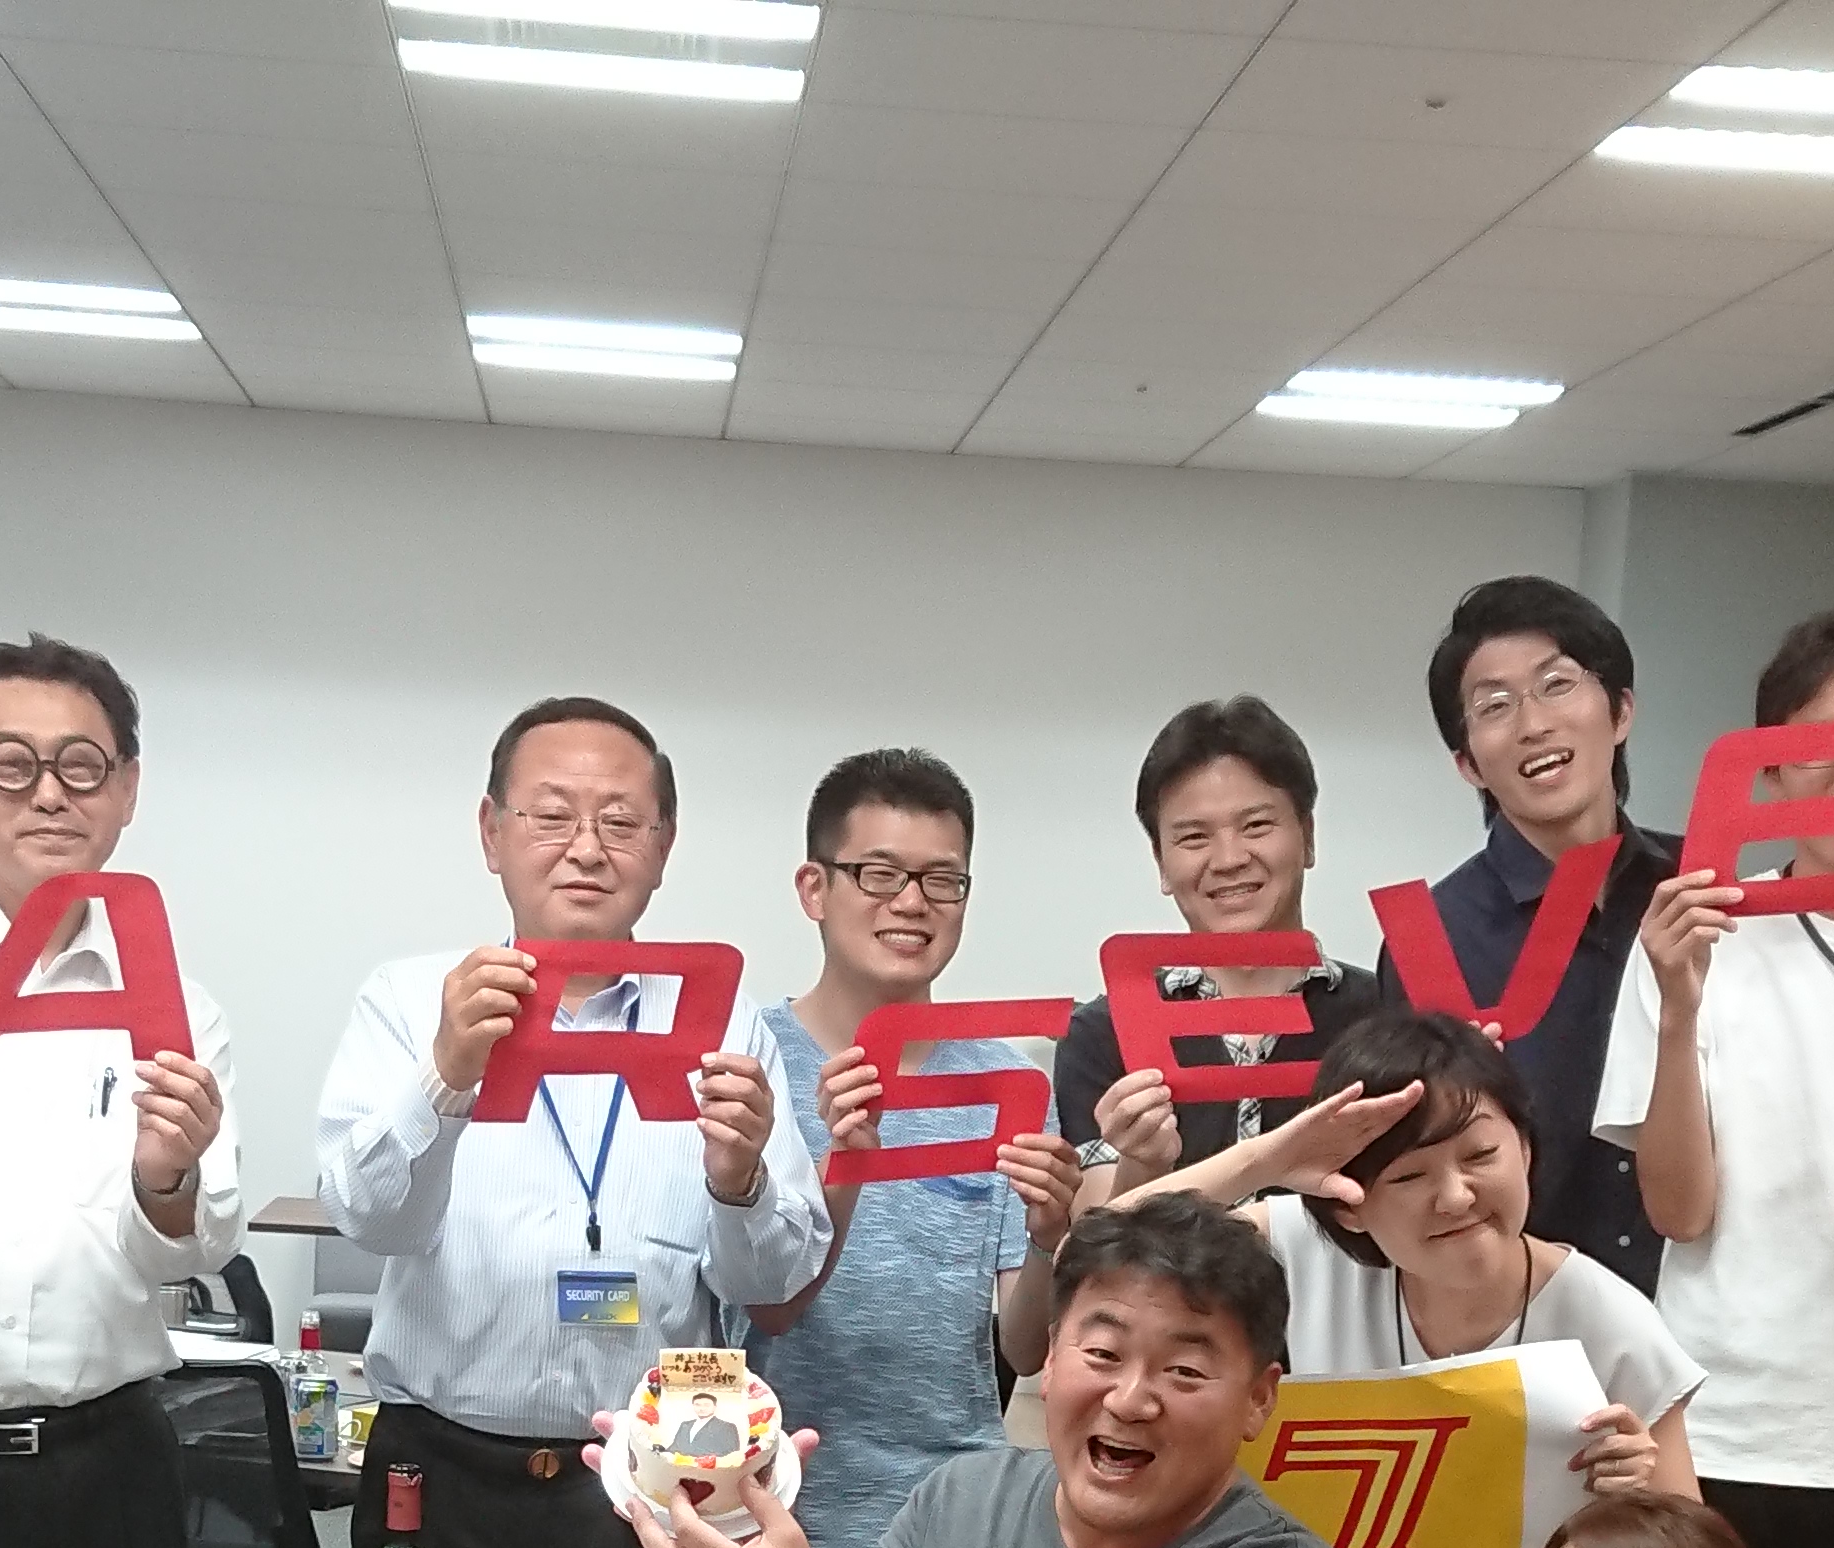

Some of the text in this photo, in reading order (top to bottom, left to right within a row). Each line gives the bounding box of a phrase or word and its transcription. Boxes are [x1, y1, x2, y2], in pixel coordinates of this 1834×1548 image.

[566, 1290, 629, 1302] SECURITY CARD
[675, 1352, 718, 1364] 井上社長
